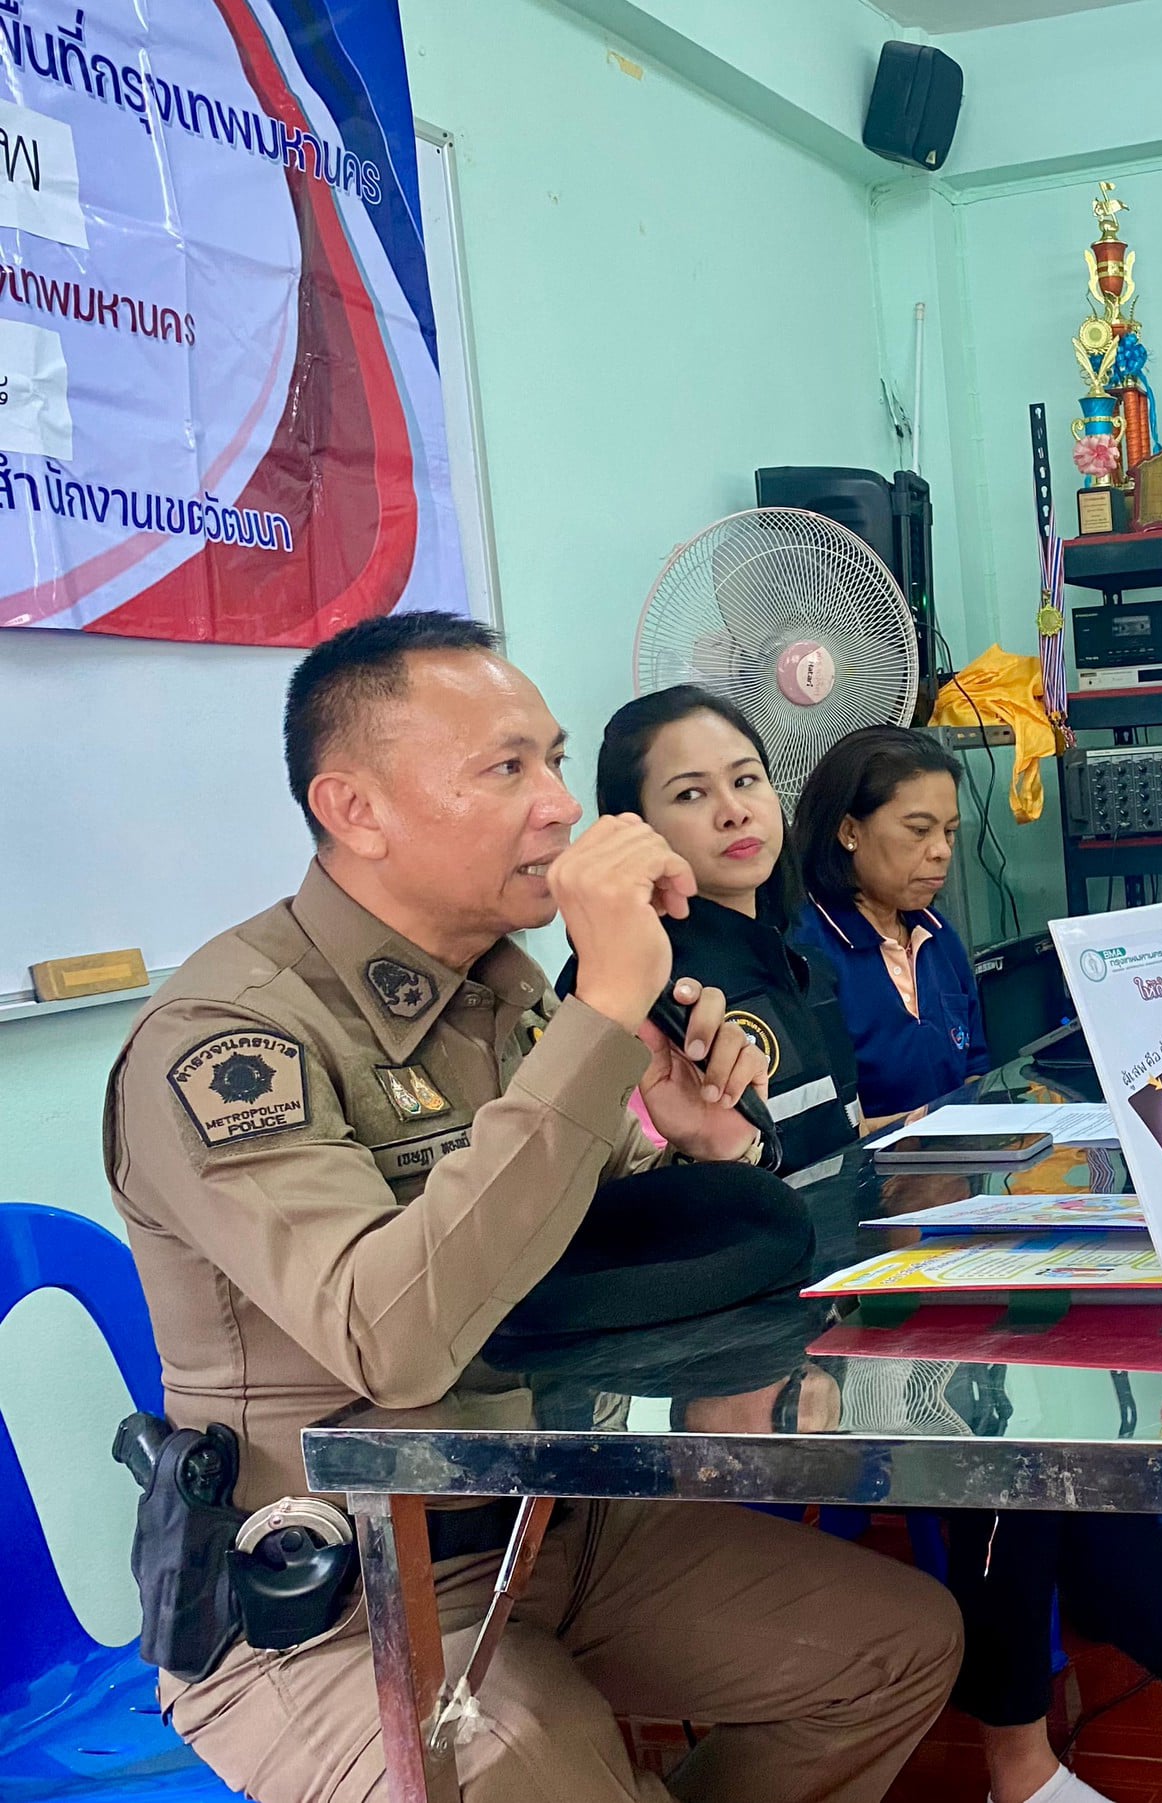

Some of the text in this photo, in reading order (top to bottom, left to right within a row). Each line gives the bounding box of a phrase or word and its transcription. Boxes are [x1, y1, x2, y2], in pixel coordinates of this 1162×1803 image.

[1102, 949, 1123, 960] BMA
[205, 1100, 302, 1131] METROPOLITAN
[227, 1114, 288, 1136] POLICE
